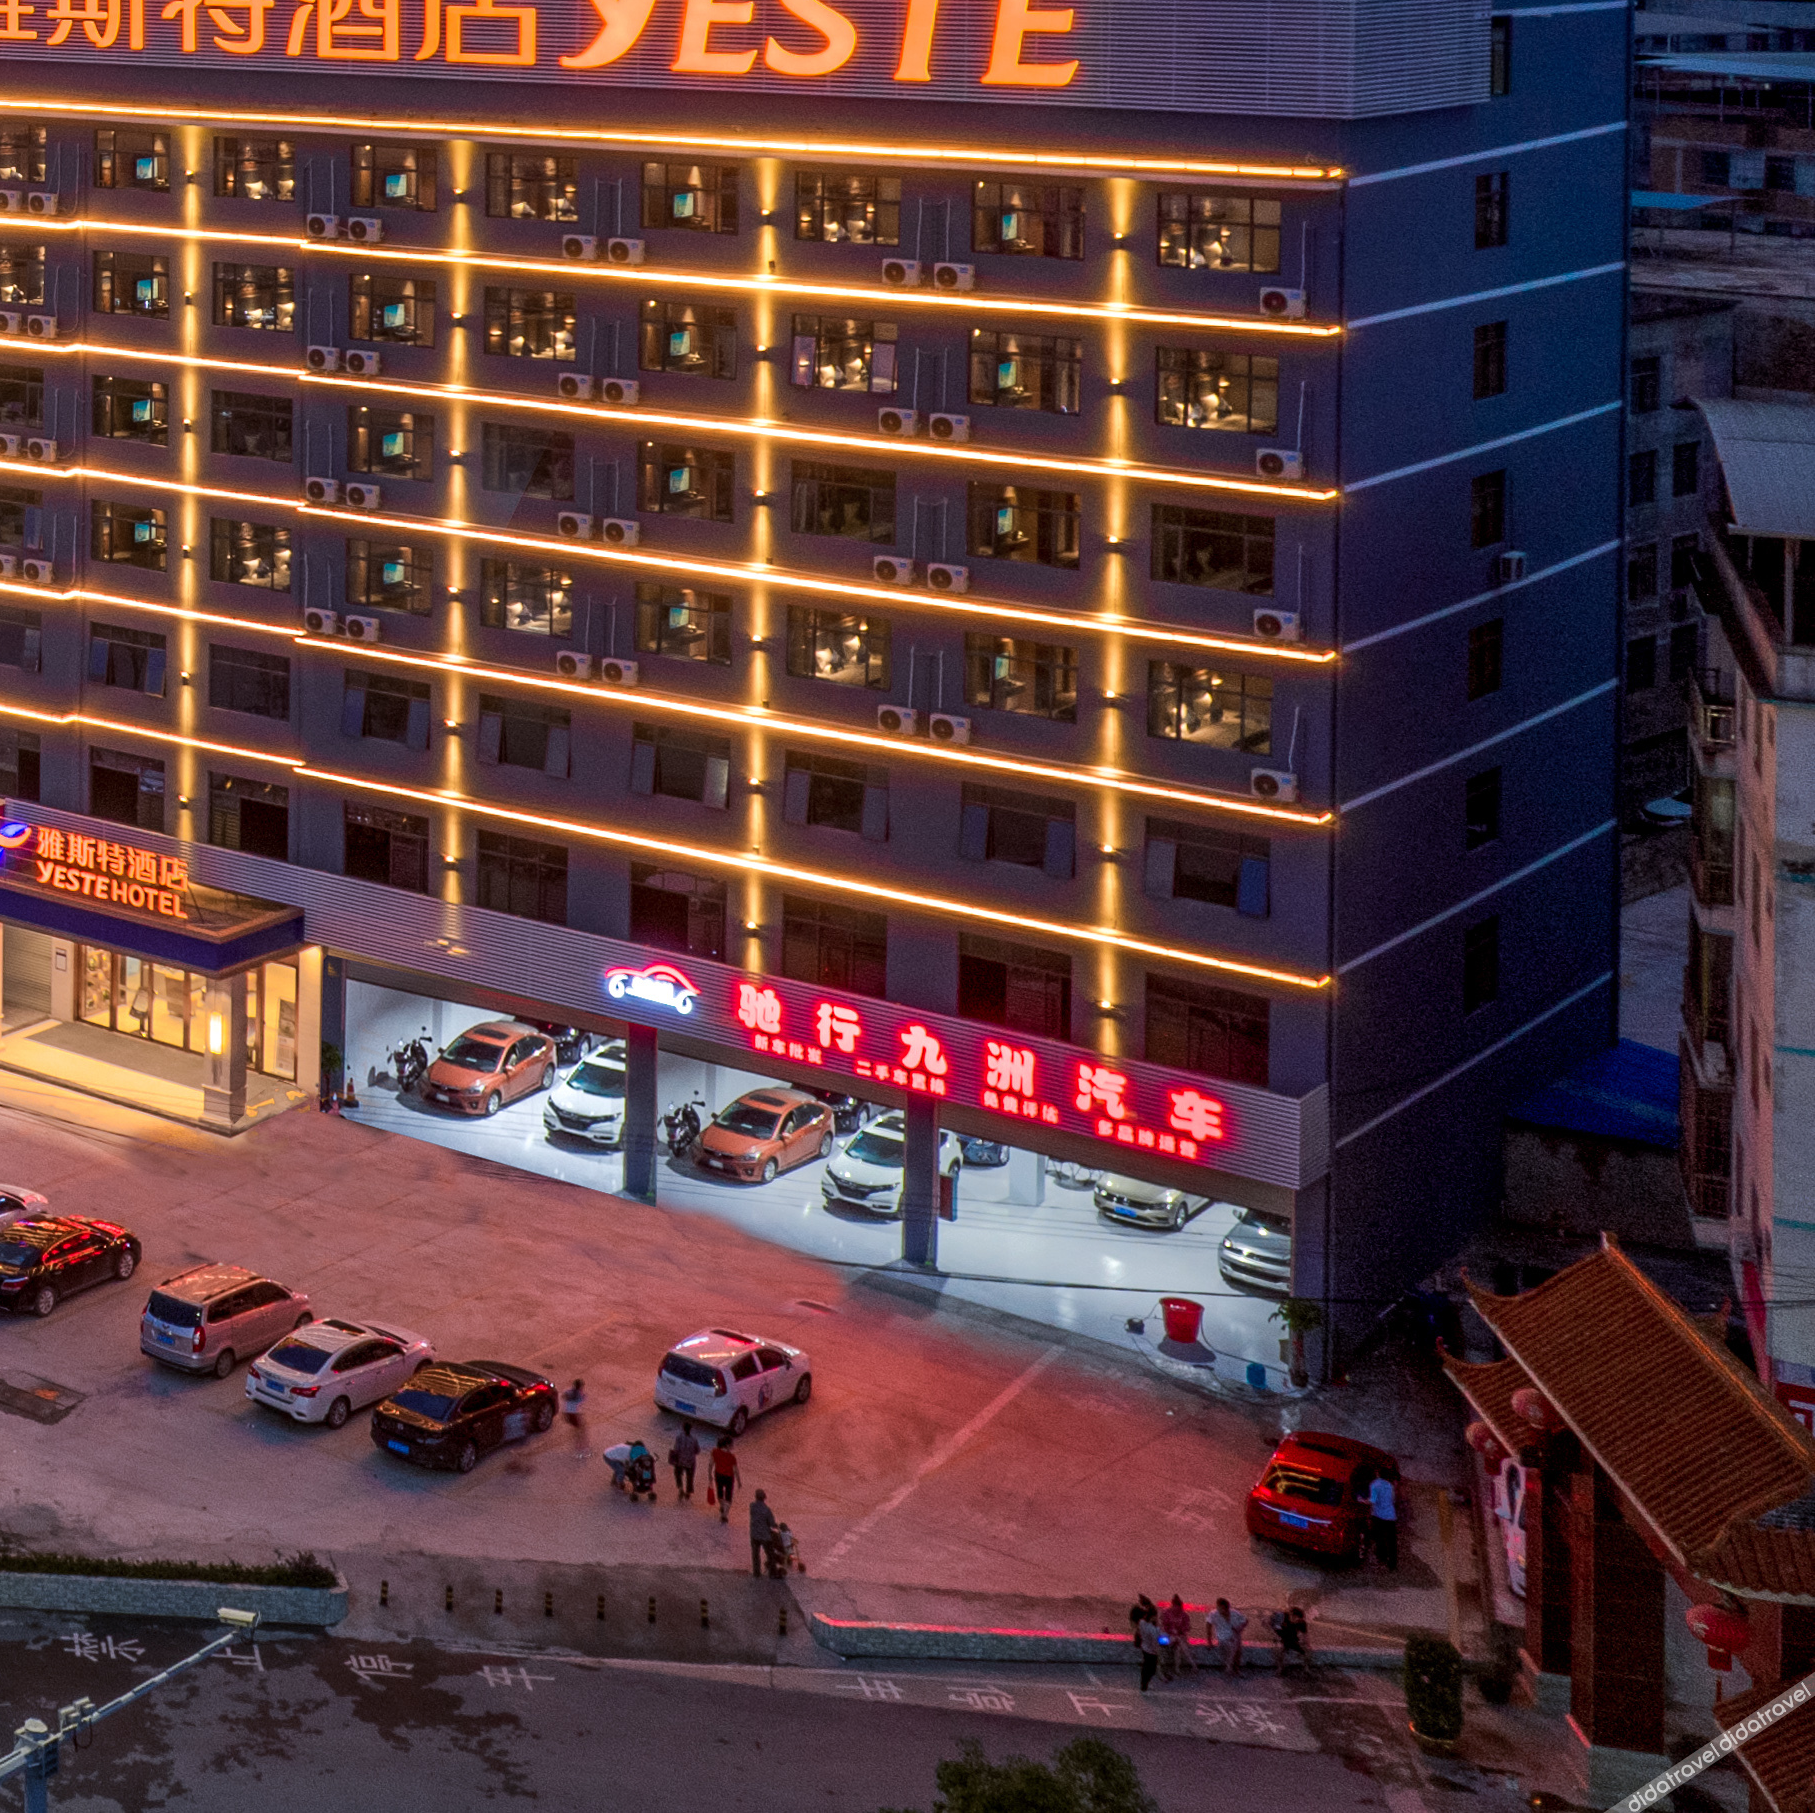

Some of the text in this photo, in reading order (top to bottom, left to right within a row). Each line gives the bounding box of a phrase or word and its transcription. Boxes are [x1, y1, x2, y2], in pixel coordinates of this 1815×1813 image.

[36, 826, 188, 892] 雅斯特酒店
[36, 860, 189, 919] YESTE HOTEL
[737, 983, 1223, 1141] 驰行九洲汽车
